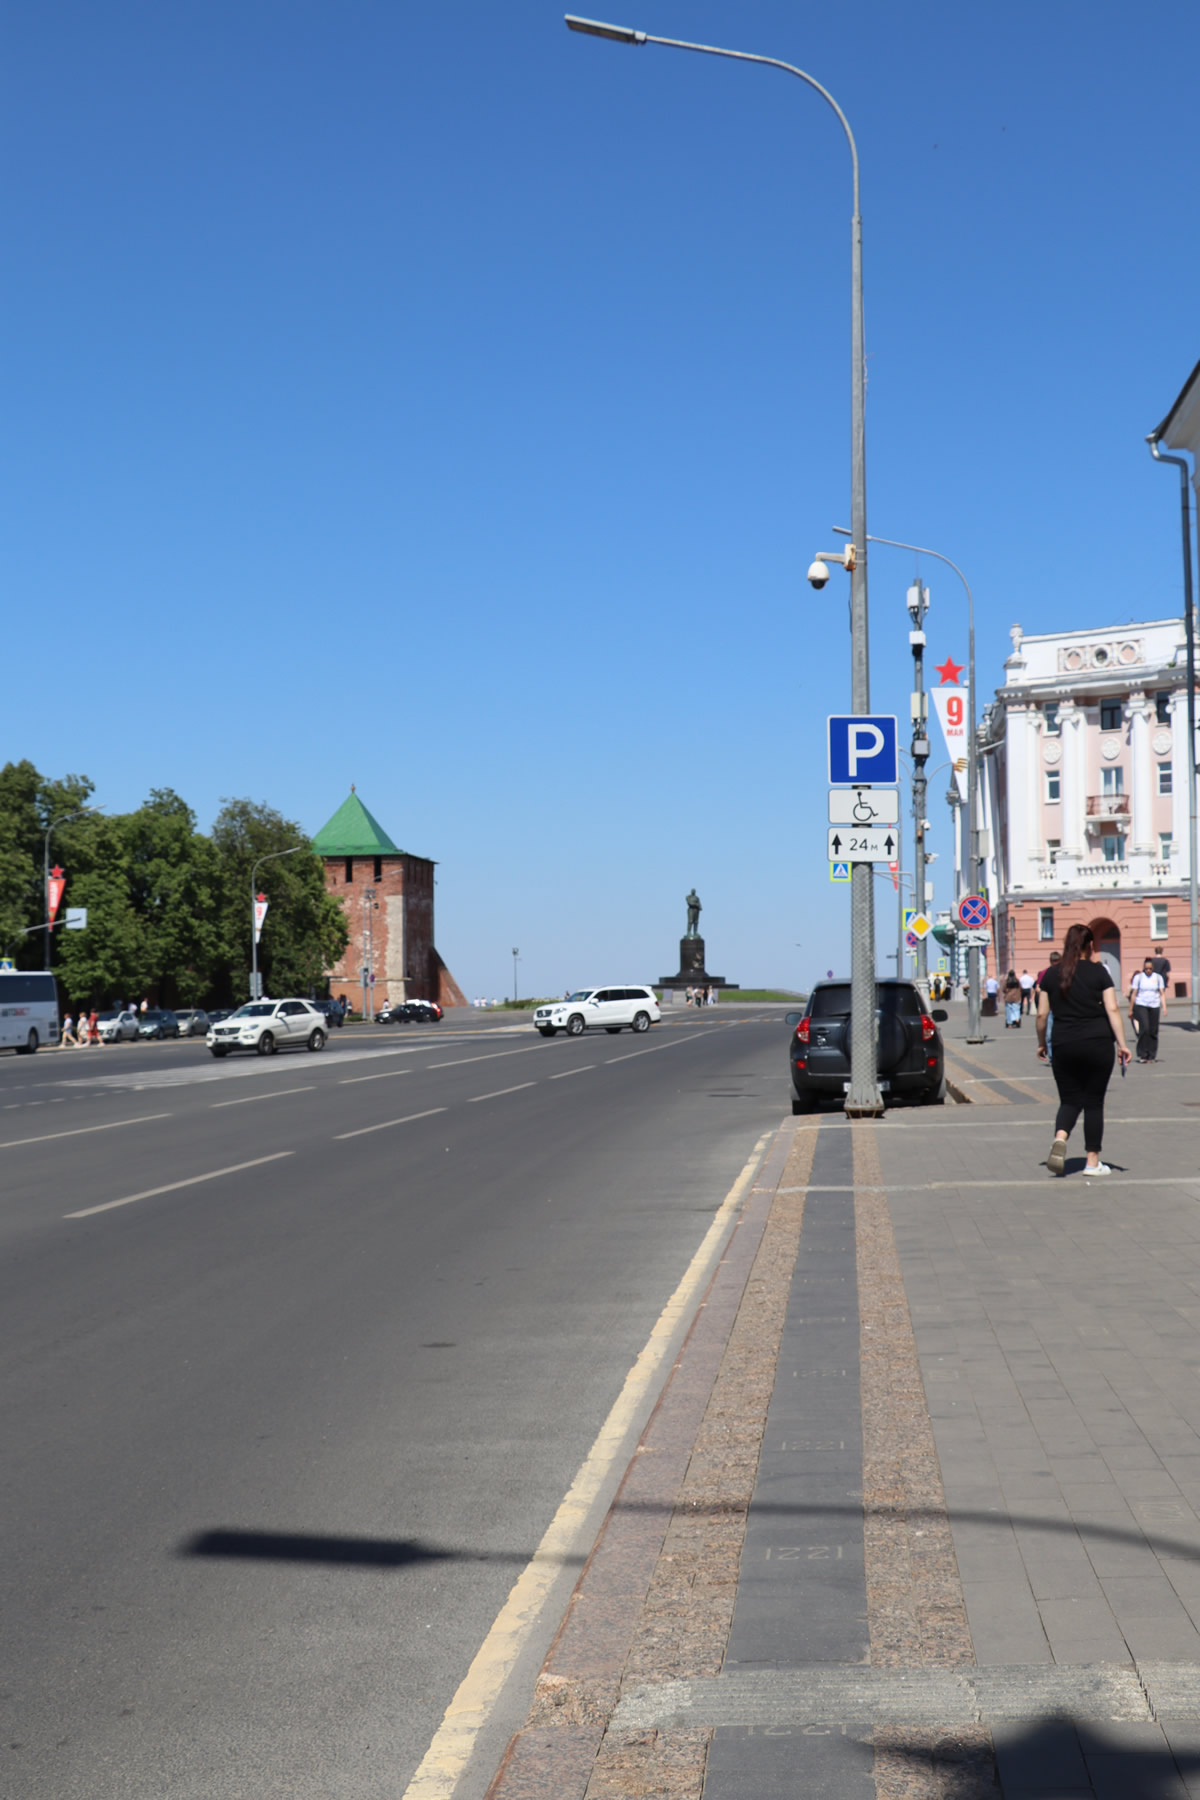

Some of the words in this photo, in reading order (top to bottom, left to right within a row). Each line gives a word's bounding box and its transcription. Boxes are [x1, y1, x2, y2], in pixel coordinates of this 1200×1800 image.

[946, 695, 963, 726] 9
[946, 728, 964, 737] МАЯ
[847, 723, 885, 777] P
[849, 838, 869, 851] 24
[765, 1546, 844, 1560] 1221
